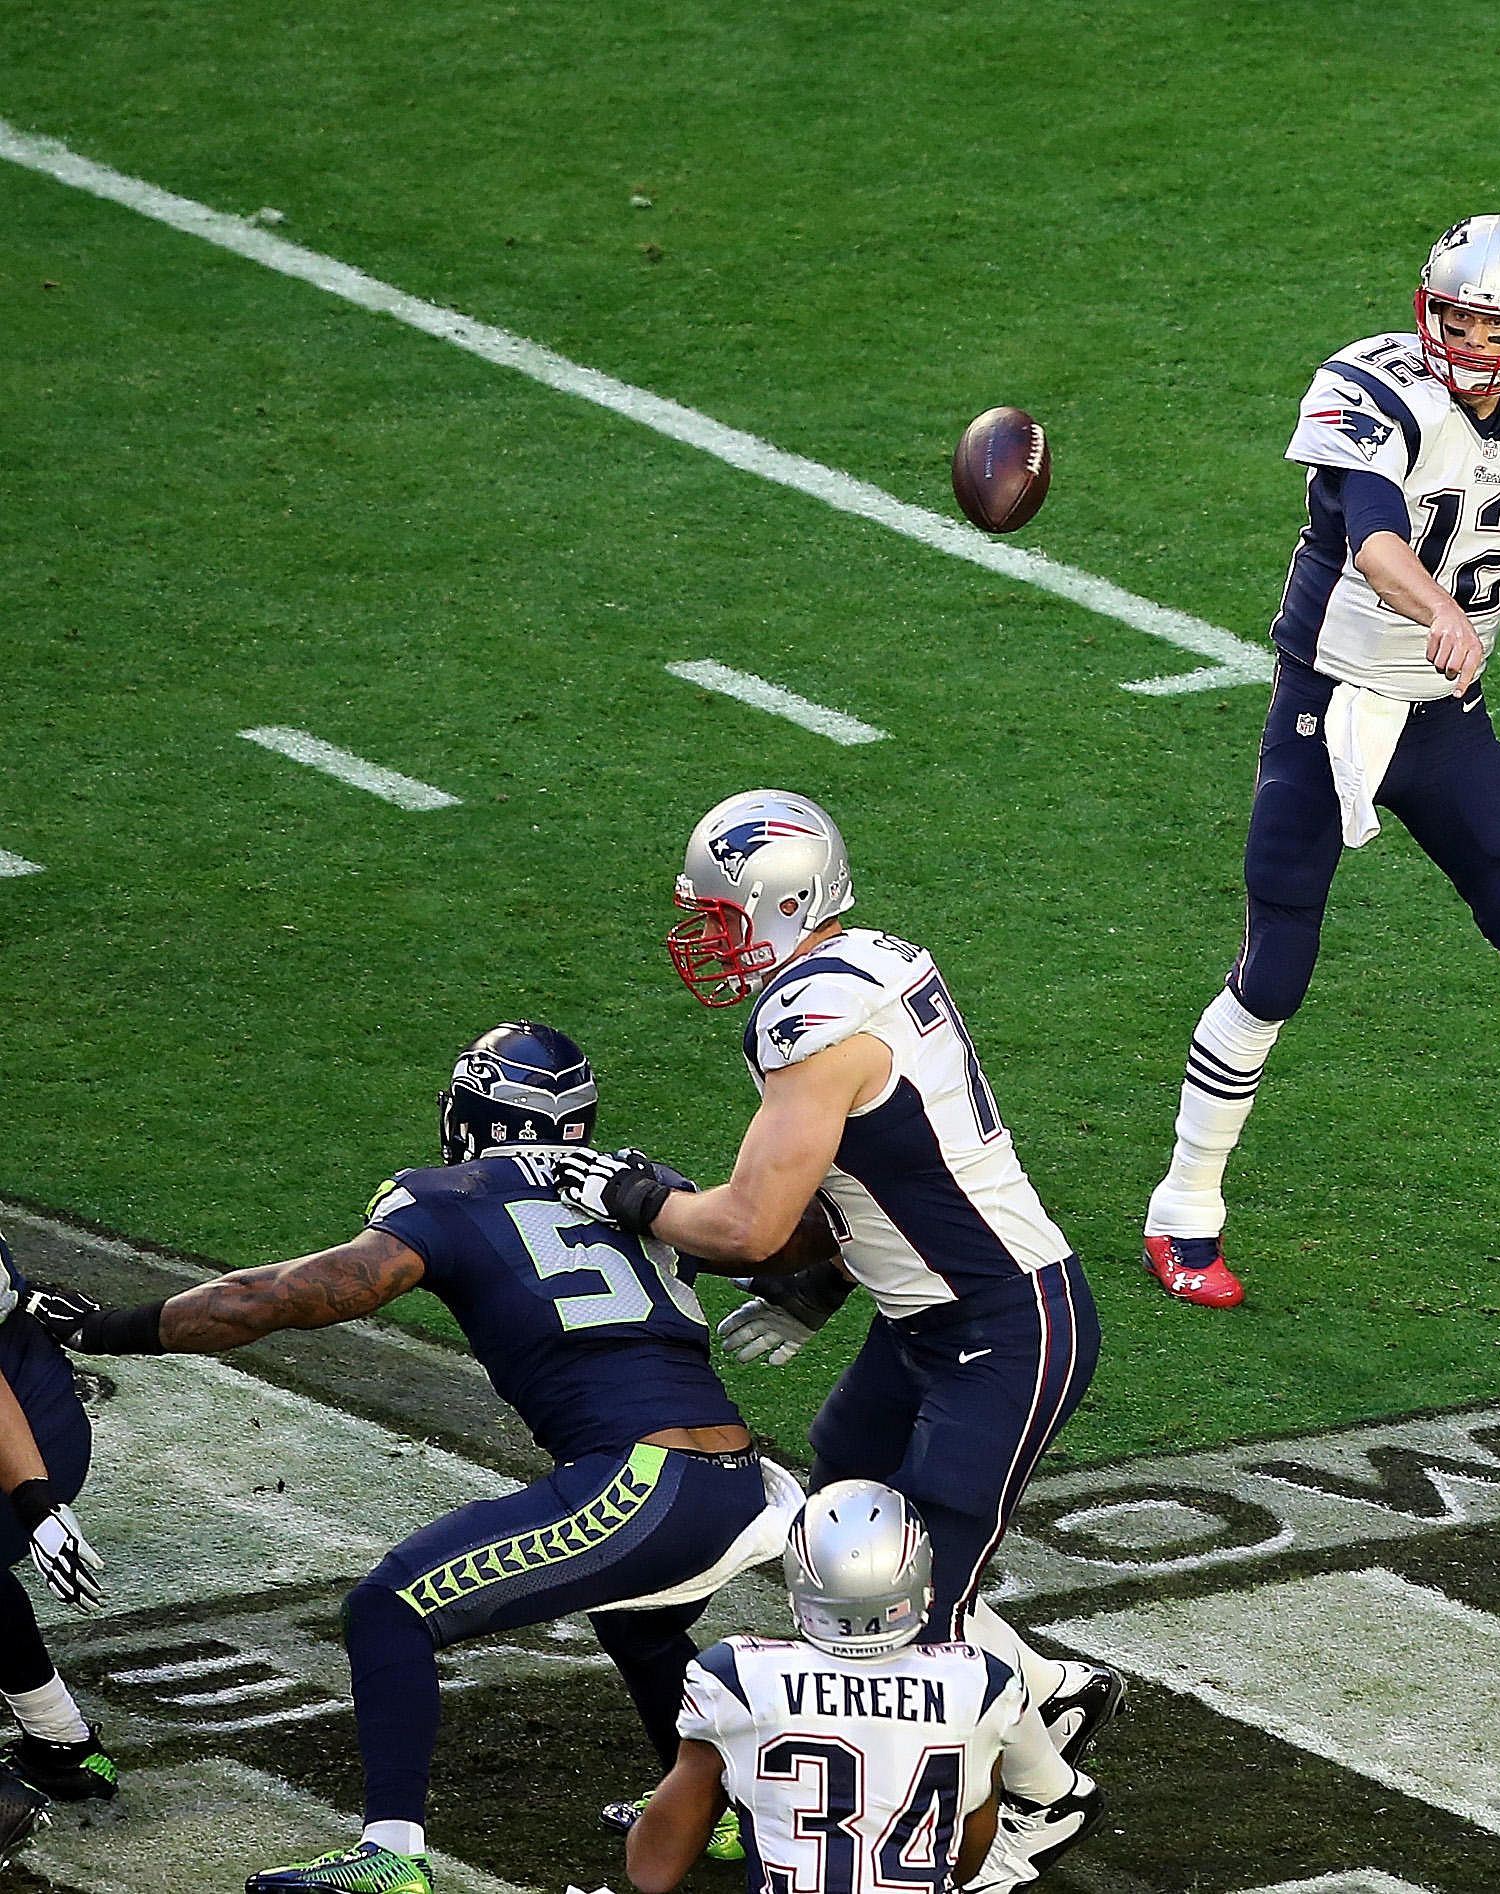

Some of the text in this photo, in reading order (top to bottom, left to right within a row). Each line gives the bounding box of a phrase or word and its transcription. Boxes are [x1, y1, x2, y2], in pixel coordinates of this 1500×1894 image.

[512, 1156, 560, 1187] IR
[838, 1616, 881, 1636] 34
[831, 1643, 895, 1656] PATRIOTS
[780, 1671, 946, 1725] VEREEN
[757, 1732, 967, 1894] 34
